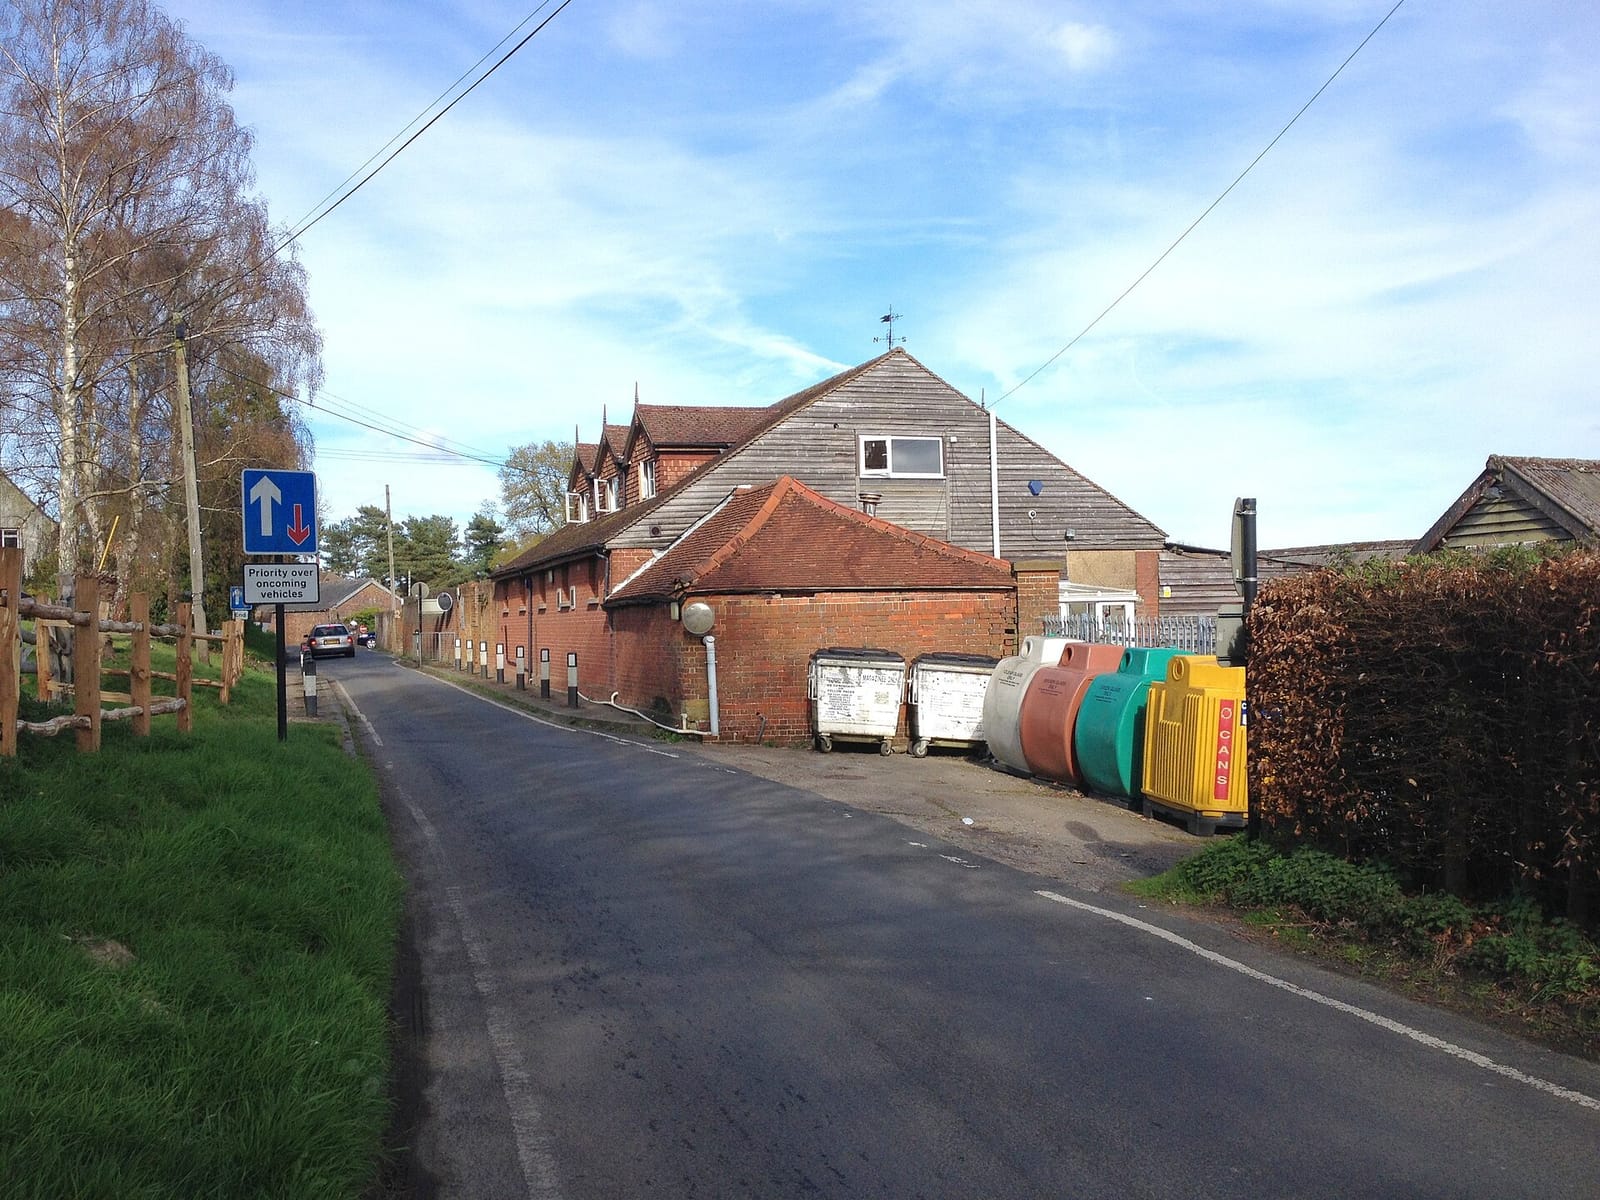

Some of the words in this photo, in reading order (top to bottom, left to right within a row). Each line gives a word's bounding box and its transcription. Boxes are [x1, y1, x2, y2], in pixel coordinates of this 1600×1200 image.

[249, 568, 288, 578] Priority
[256, 579, 307, 588] oncoming
[261, 590, 303, 598] vehicles
[1217, 731, 1231, 784] CANS
